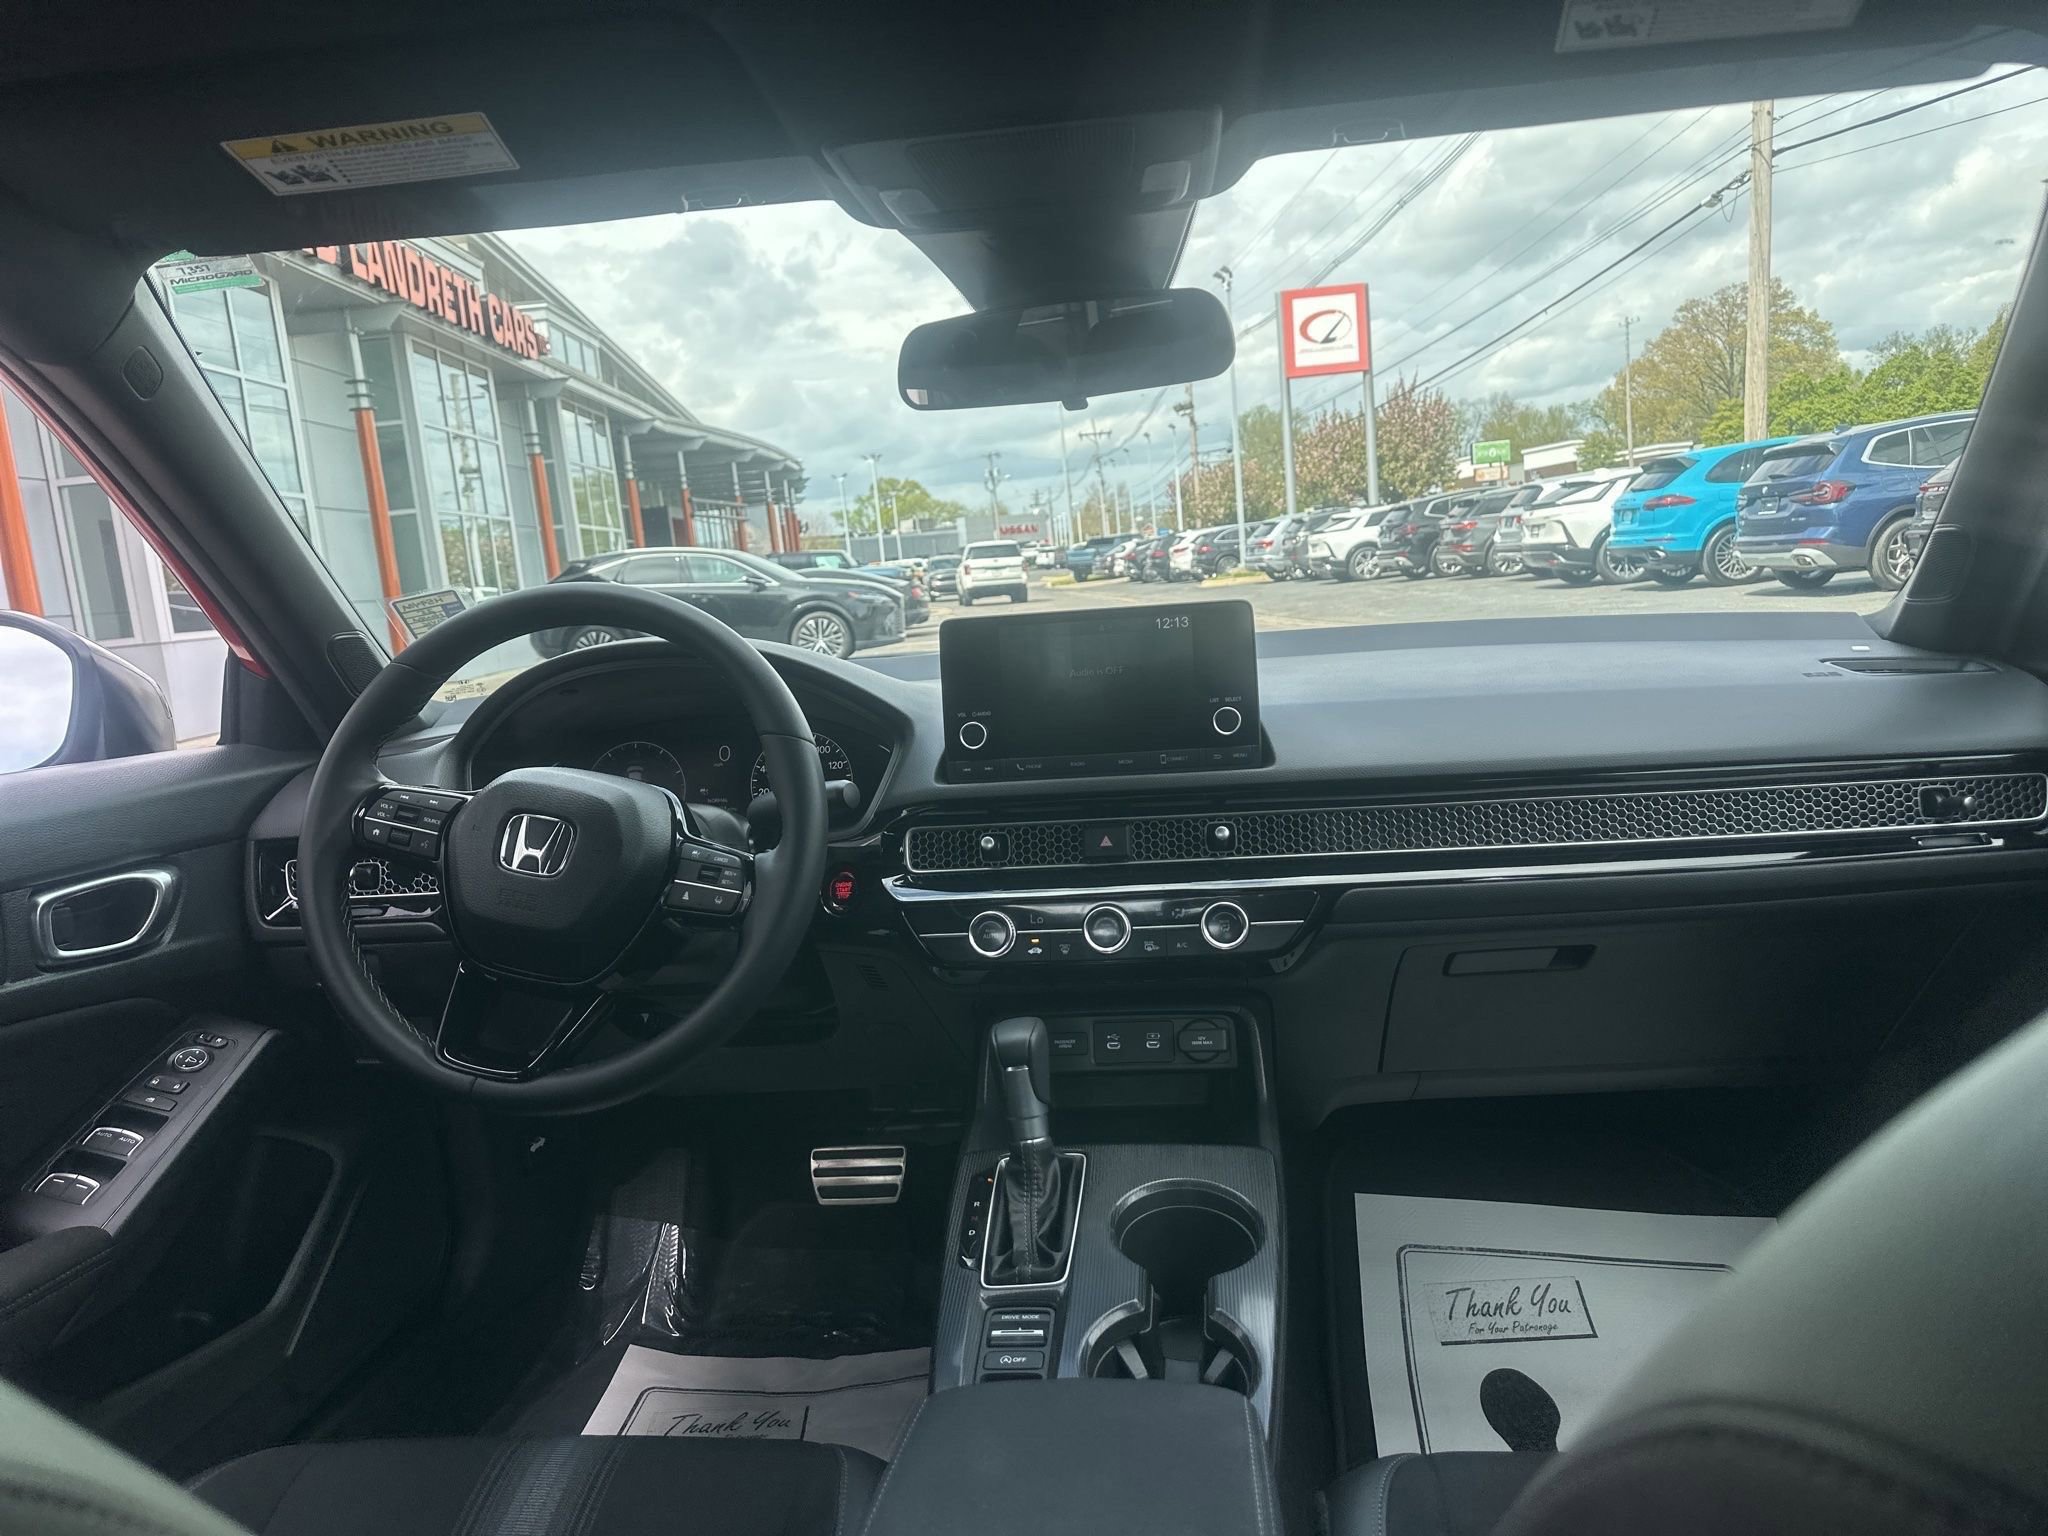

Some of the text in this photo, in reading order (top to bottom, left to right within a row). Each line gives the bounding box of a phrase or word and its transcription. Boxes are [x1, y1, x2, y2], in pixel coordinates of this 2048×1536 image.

[307, 121, 454, 149] WARNING
[351, 241, 539, 360] LANDRETH CARS
[1155, 616, 1190, 630] 12:13
[718, 745, 731, 762] 0
[828, 760, 844, 770] 120
[423, 816, 441, 826] SOURCE
[119, 1136, 136, 1144] AUTO
[1446, 1282, 1572, 1321] Thank You
[1468, 1319, 1559, 1335] For Your Patronage
[664, 1410, 792, 1437] Thank You
